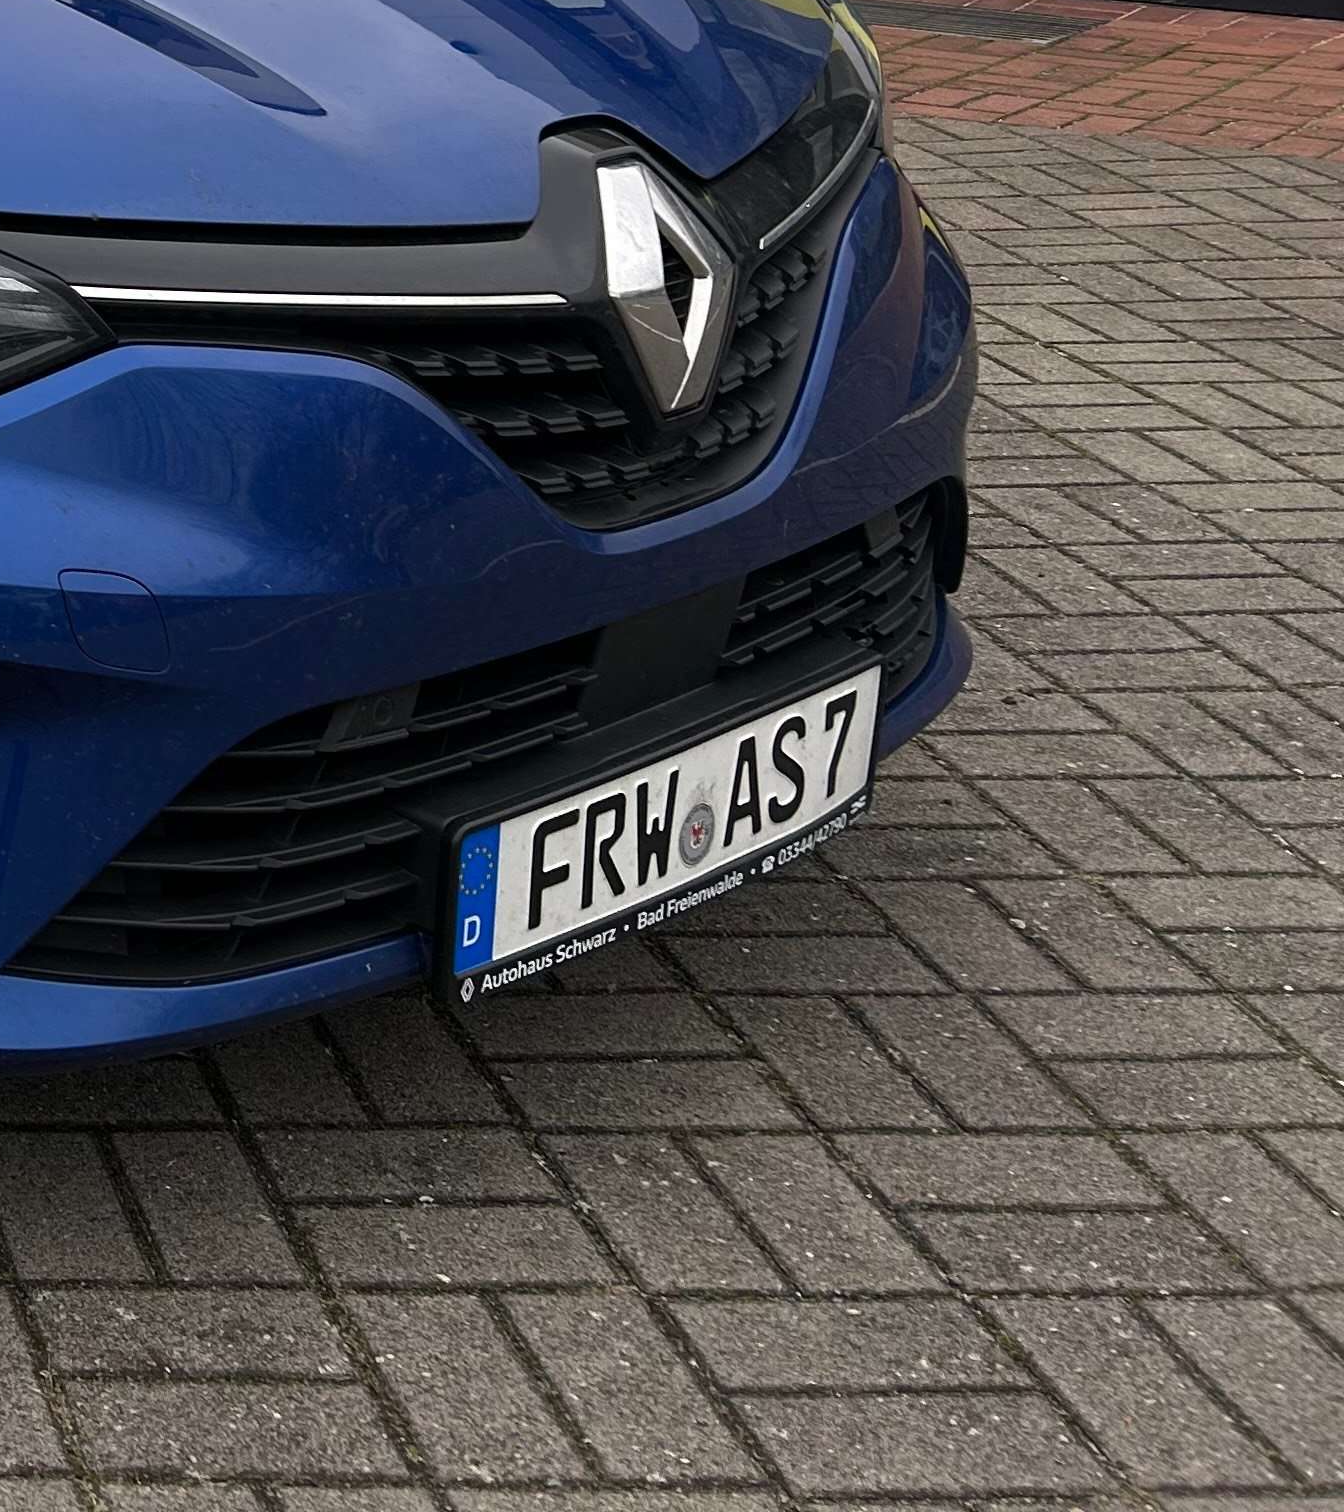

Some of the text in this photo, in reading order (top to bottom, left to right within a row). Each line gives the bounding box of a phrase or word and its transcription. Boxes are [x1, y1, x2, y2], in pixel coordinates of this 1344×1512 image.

[528, 690, 857, 930] FRW AS 7
[463, 915, 481, 948] D
[481, 952, 553, 994] Autohaus
[555, 927, 617, 964] Schwarz
[636, 903, 665, 930] Bad
[666, 870, 744, 918] Freienwalde
